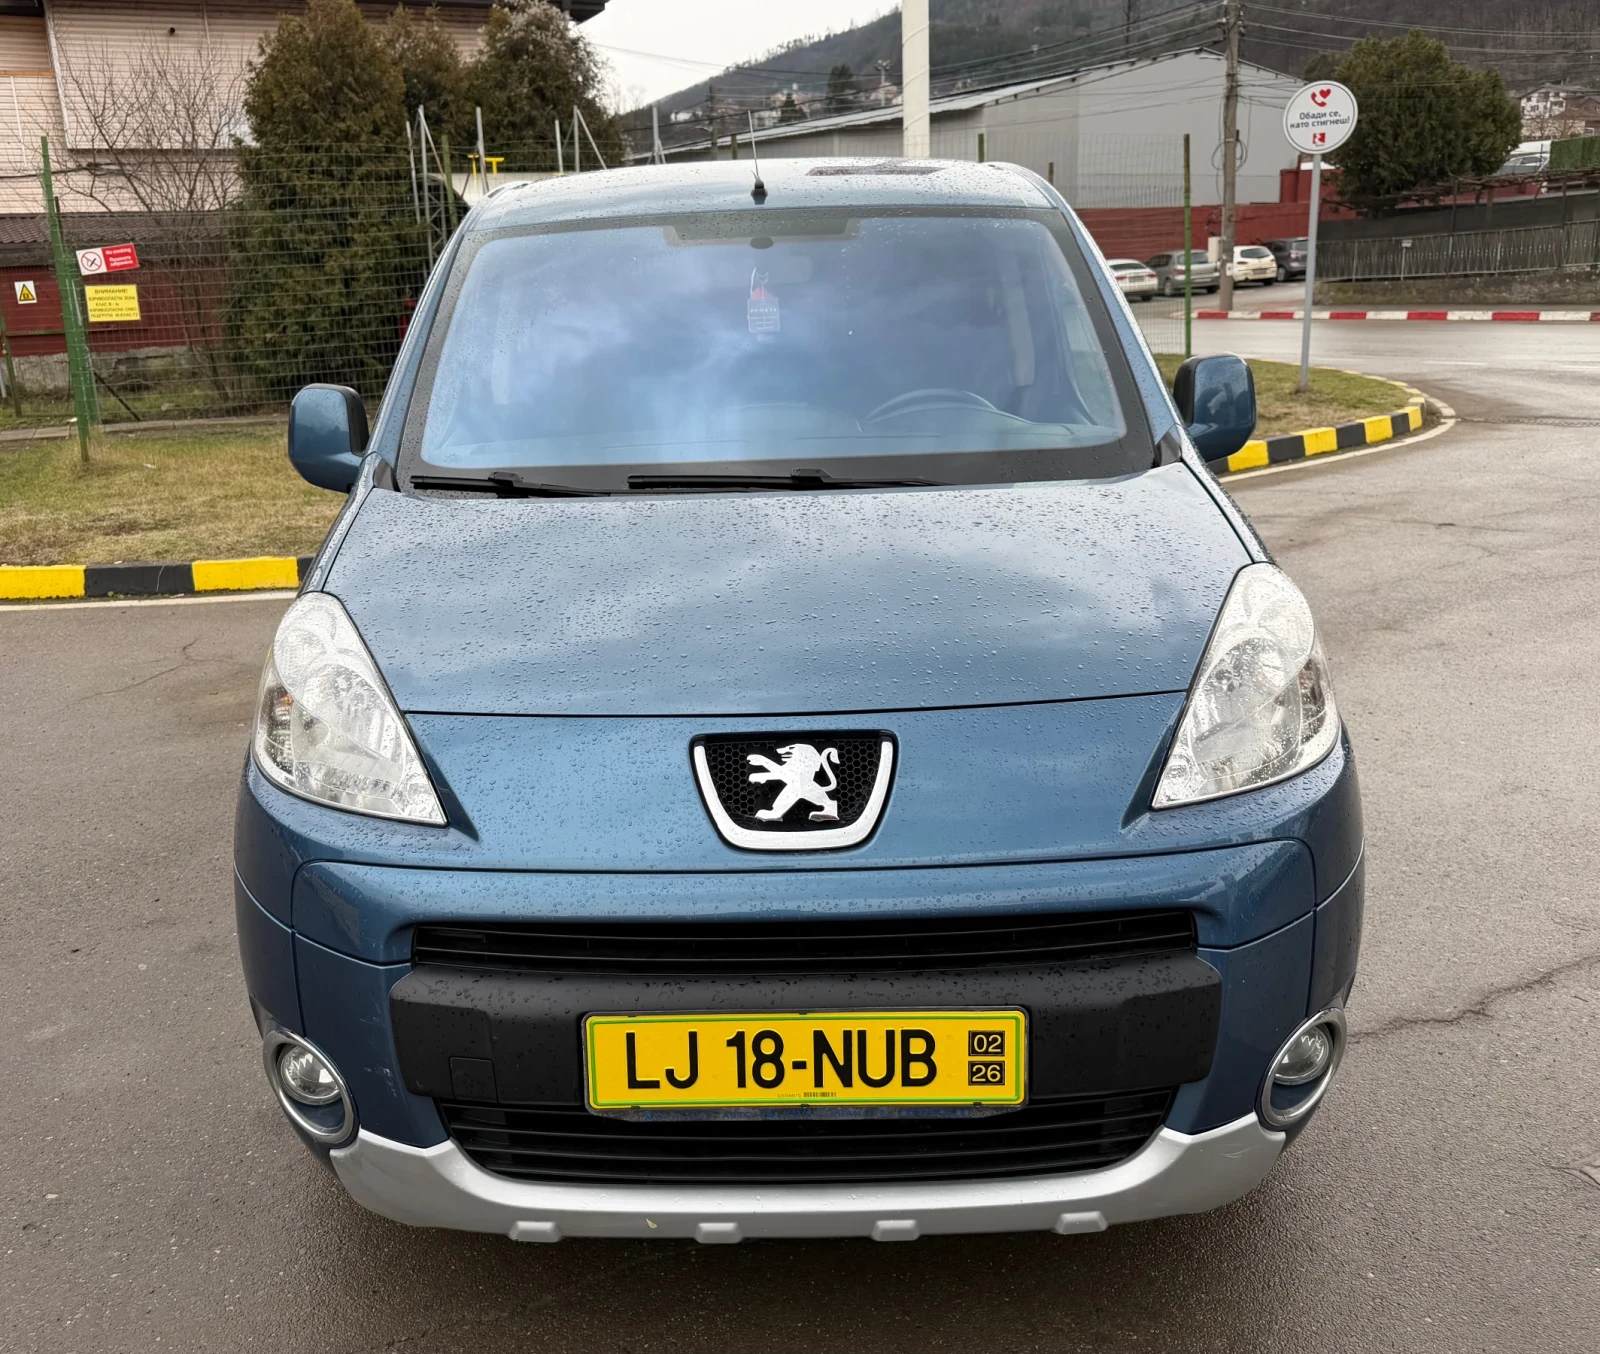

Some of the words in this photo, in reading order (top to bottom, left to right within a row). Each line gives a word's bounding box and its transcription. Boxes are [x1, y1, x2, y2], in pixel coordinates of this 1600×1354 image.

[1290, 121, 1309, 129] като
[1311, 116, 1350, 127] стигнеш!
[1299, 112, 1327, 120] Обади
[973, 1034, 1002, 1053] 02
[626, 1031, 699, 1089] LJ
[726, 1029, 937, 1089] 18-NUB
[972, 1064, 1002, 1083] 26
